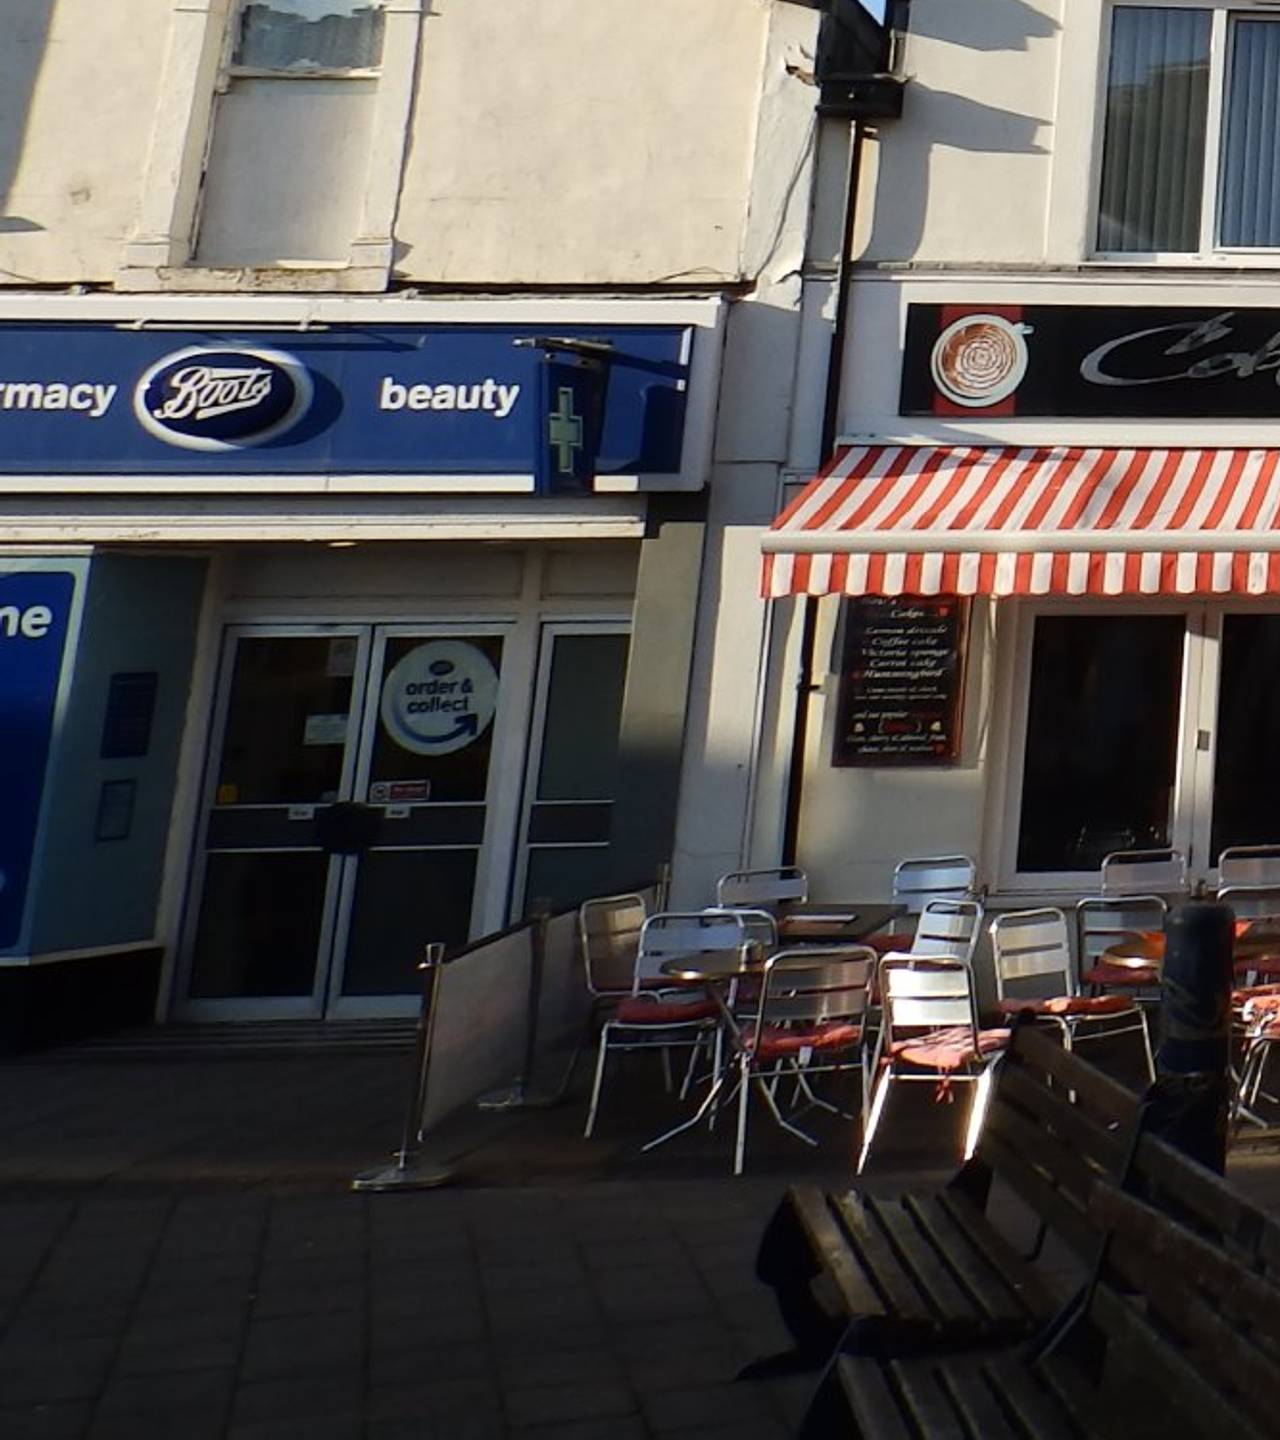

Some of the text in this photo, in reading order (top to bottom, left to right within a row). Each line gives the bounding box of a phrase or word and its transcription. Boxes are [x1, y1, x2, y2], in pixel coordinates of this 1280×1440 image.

[154, 364, 274, 422] Boots
[379, 376, 521, 417] beauty
[404, 677, 474, 696] order &
[406, 696, 469, 714] collect
